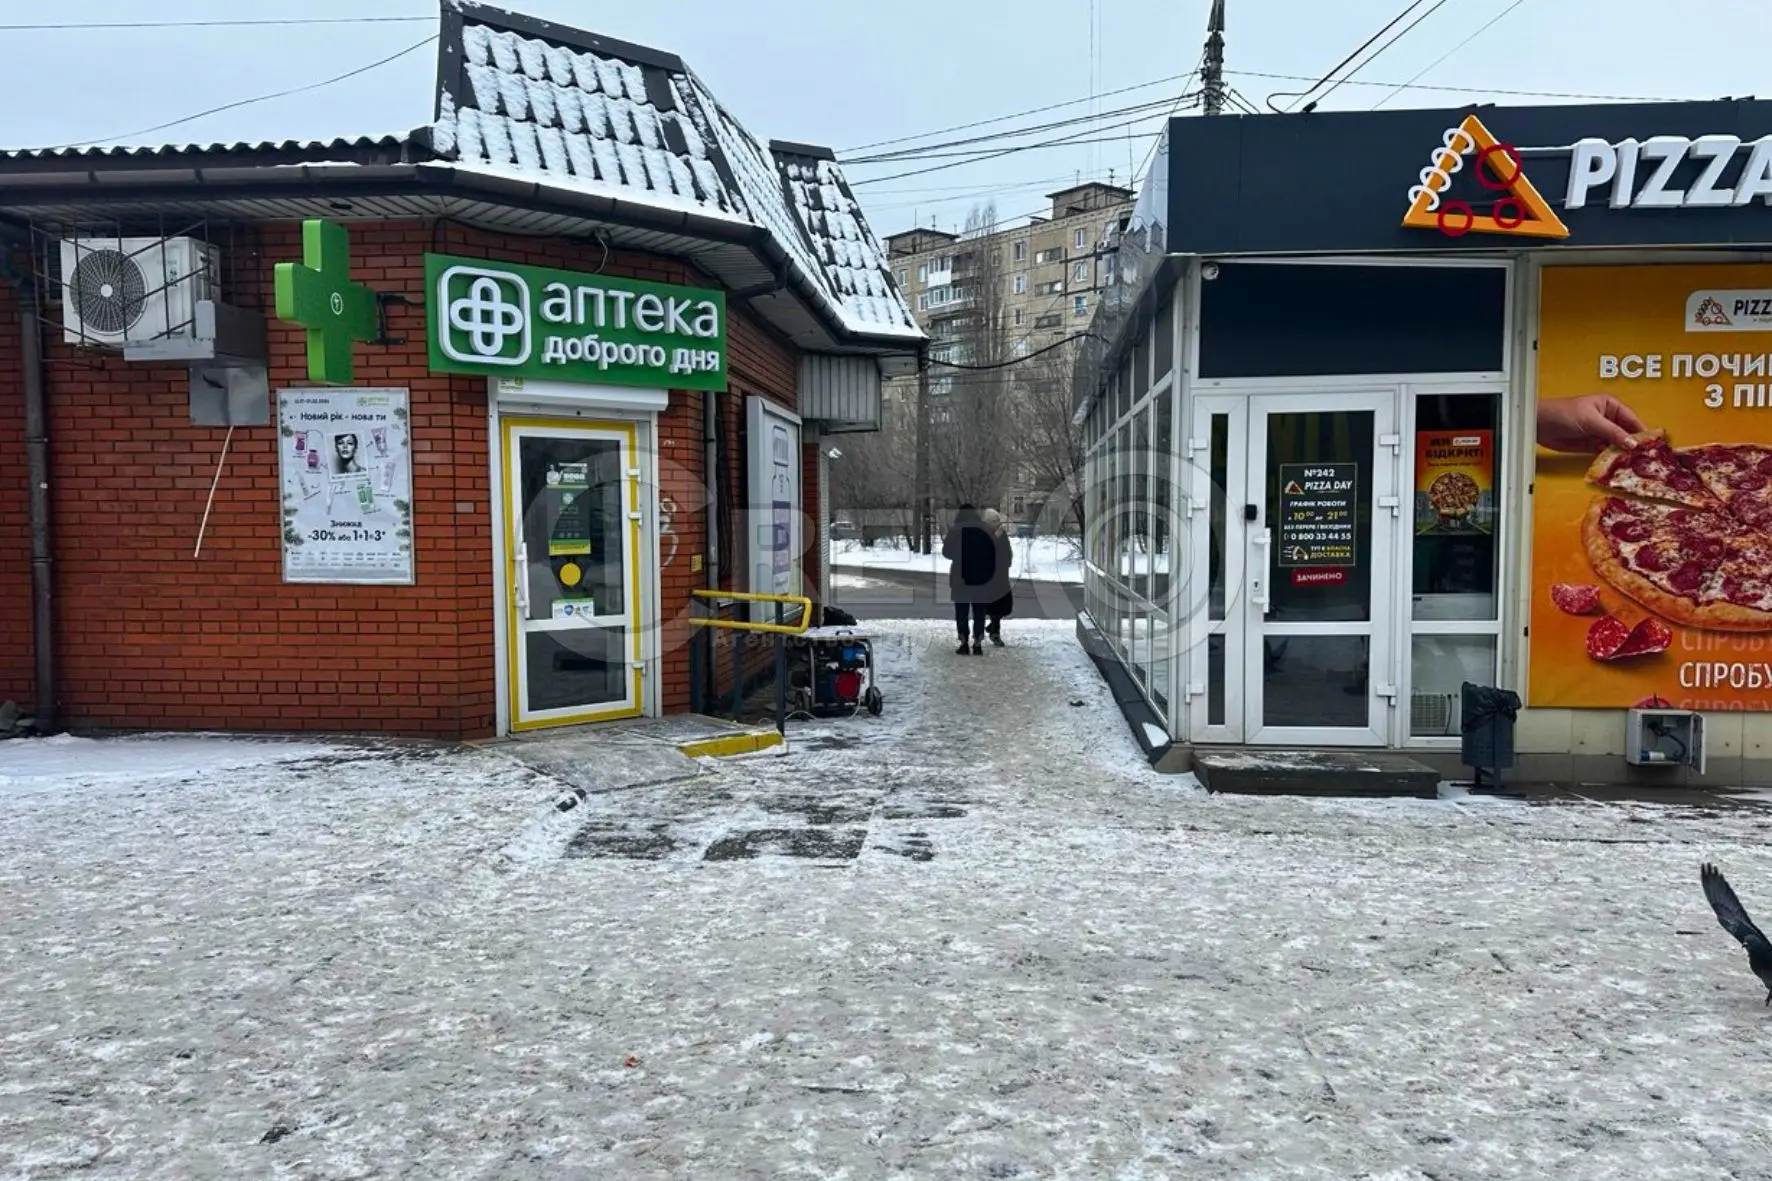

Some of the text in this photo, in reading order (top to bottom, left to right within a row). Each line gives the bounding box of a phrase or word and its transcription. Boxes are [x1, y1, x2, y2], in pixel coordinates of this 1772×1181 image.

[540, 282, 719, 338] аптека
[542, 334, 720, 374] доброго дня
[1600, 354, 1772, 378] ВСЕ ПОЧИ
[1704, 384, 1772, 408] З ПІ
[300, 411, 328, 421] Новий
[330, 412, 343, 423] рік
[1304, 480, 1352, 490] PIZZA DAY
[330, 520, 362, 528] Знижка
[308, 530, 336, 541] -30%
[1297, 572, 1342, 581] ЗАЧИНЕНО
